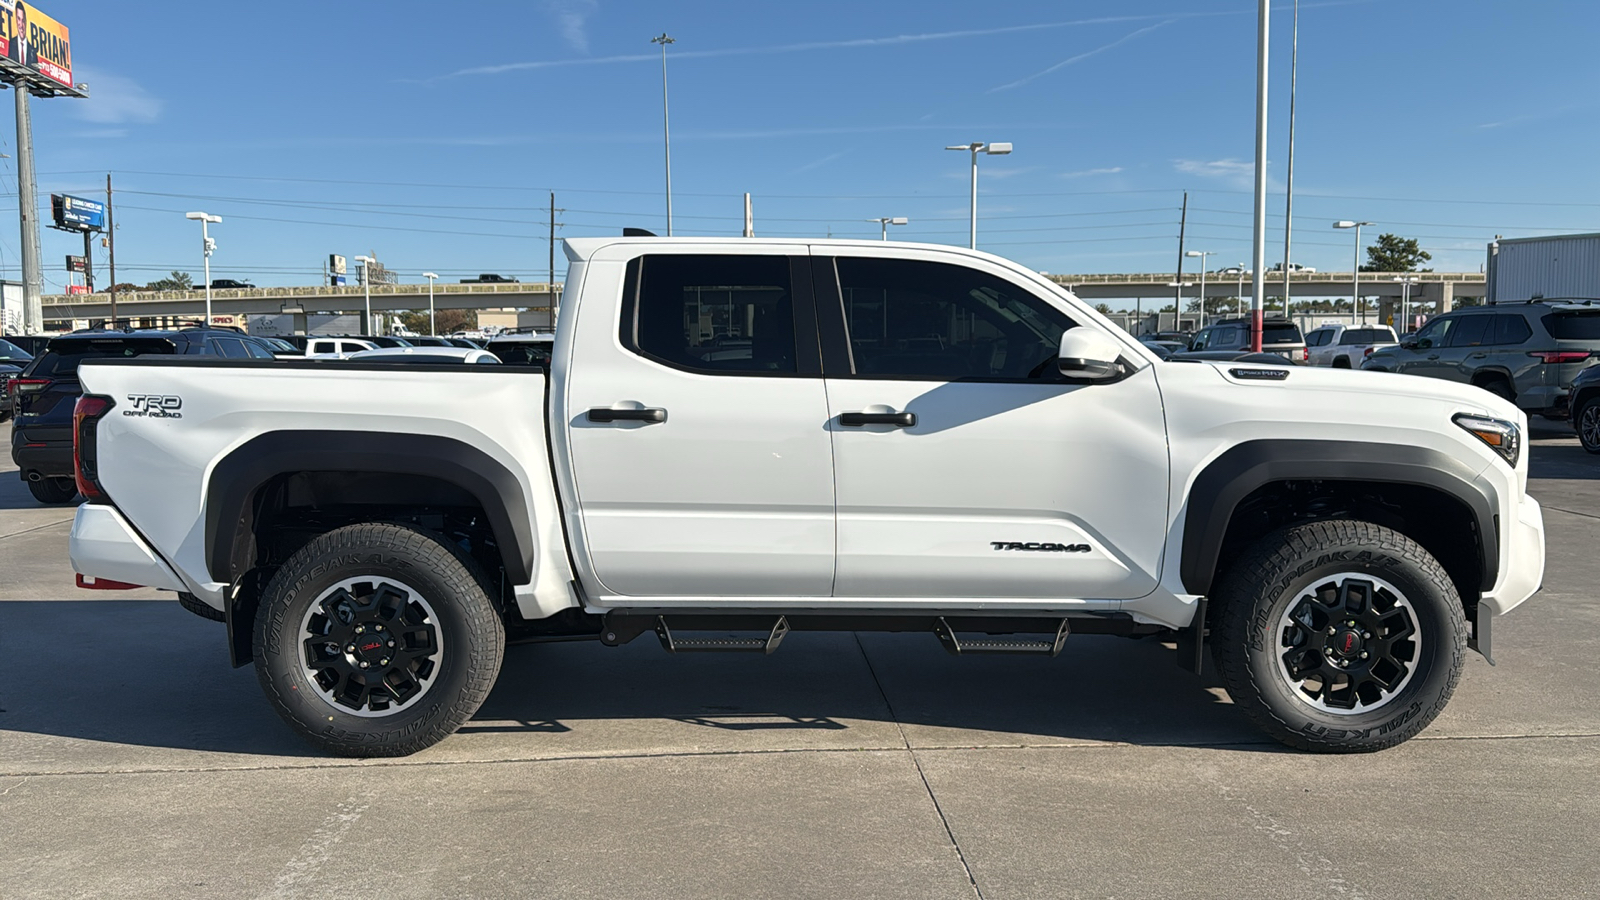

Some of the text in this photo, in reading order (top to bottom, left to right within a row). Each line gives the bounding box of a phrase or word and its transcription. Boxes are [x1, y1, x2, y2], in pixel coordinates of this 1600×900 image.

[30, 21, 70, 70] BRIAN!
[127, 394, 182, 412] TRD
[149, 411, 182, 419] ROAD
[990, 541, 1092, 553] TACOMA
[268, 552, 361, 656] WILDPEAK
[1251, 550, 1351, 652] WILDPEAK
[1344, 633, 1353, 653] TRD
[320, 702, 444, 744] FALKEN
[1303, 700, 1424, 739] FALKEN
